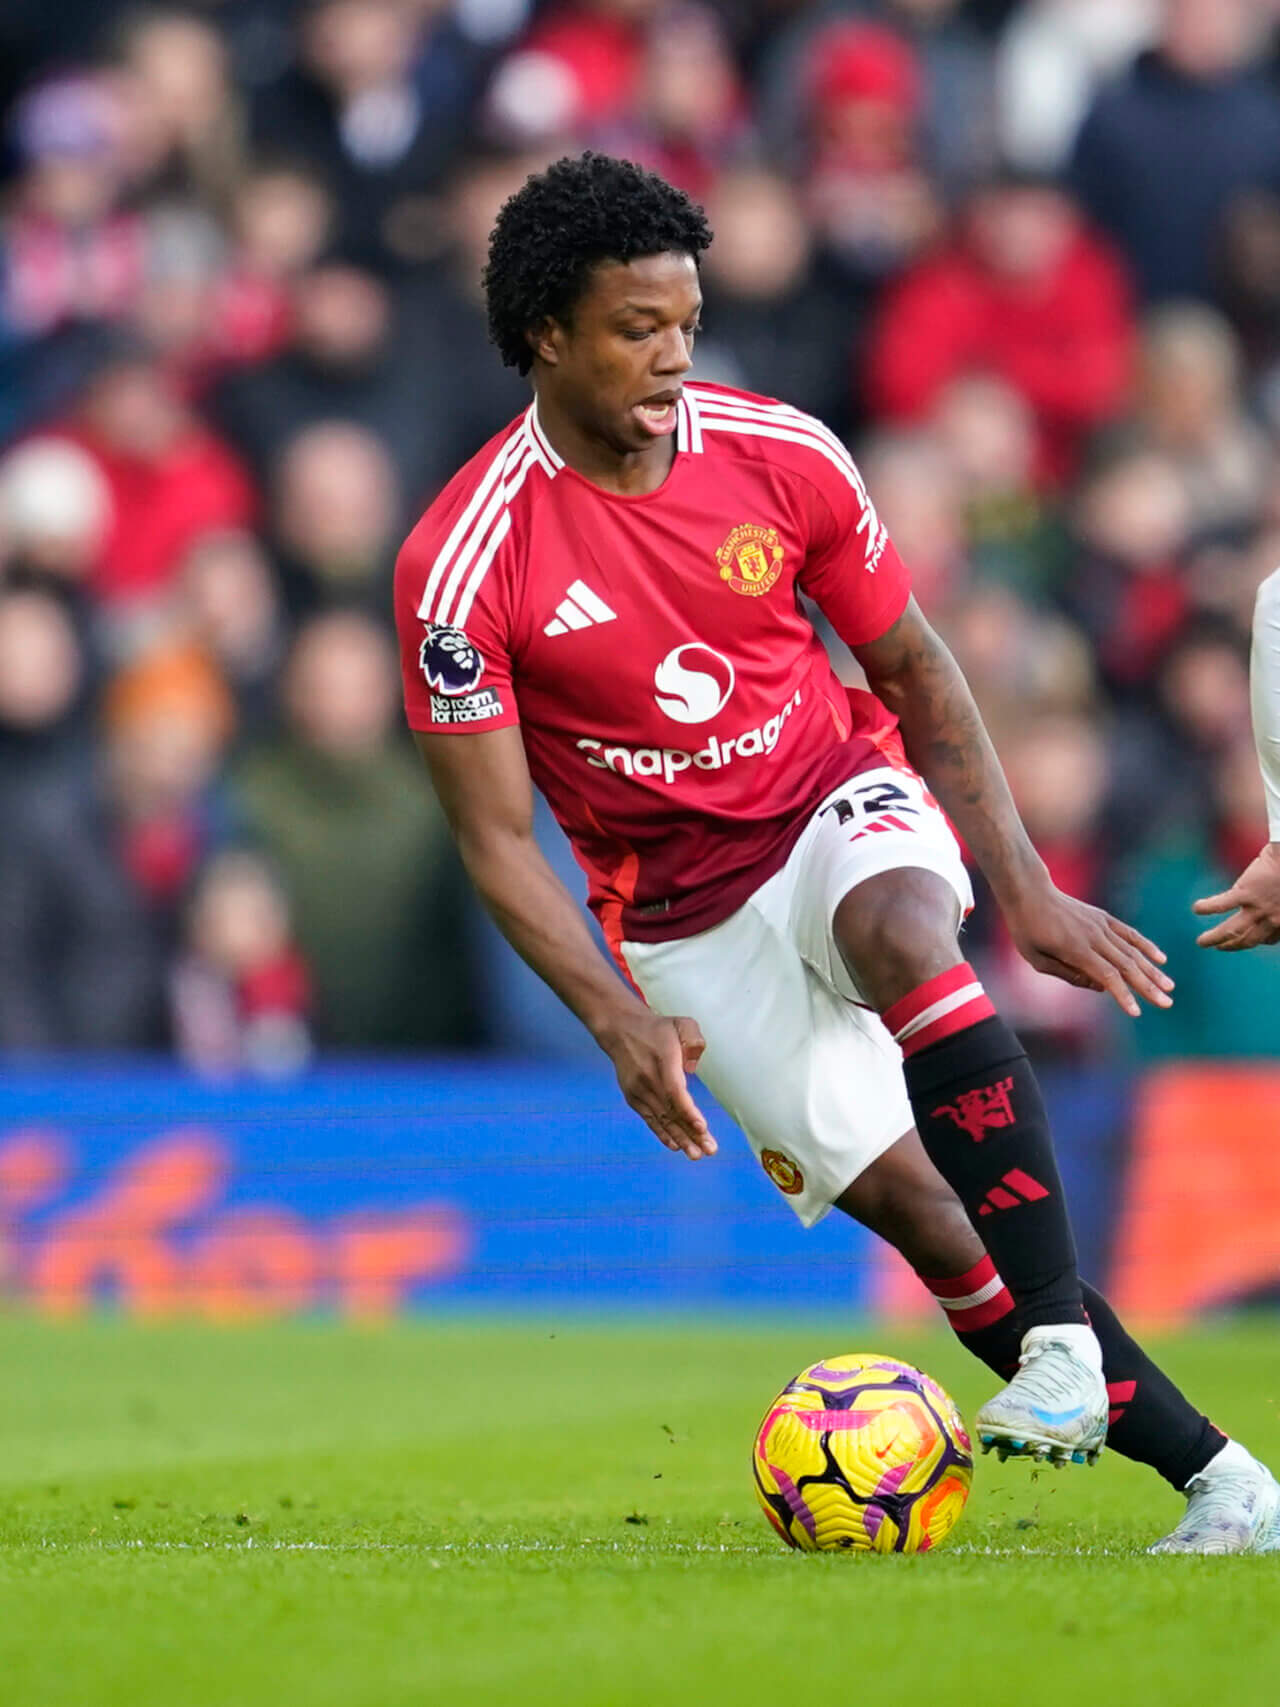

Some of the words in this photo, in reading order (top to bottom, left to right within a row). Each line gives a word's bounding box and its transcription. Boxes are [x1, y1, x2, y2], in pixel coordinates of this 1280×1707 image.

[721, 527, 776, 561] MANCHESTER
[741, 570, 776, 594] UNITED
[430, 694, 450, 712] No
[451, 690, 494, 712] room
[431, 706, 452, 723] for
[453, 701, 504, 723] racism
[576, 688, 803, 784] Snapdrag
[818, 782, 920, 827] 12
